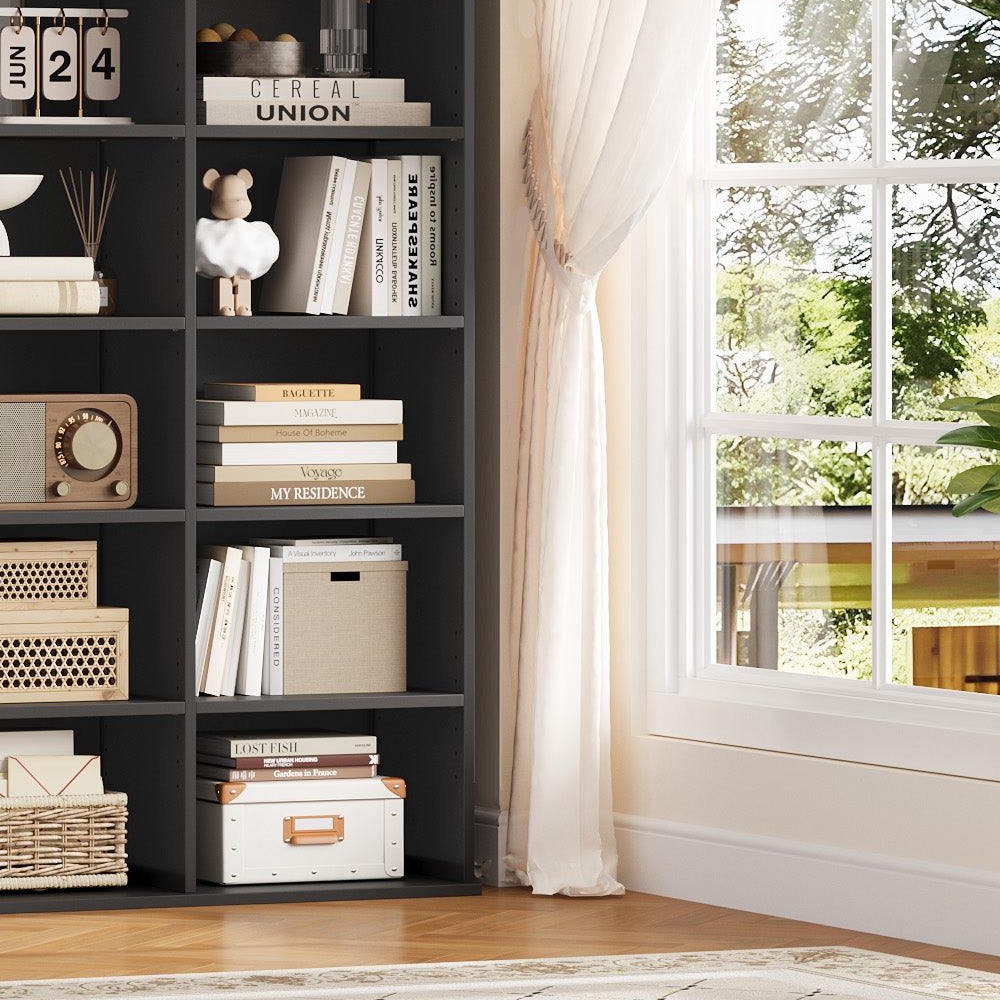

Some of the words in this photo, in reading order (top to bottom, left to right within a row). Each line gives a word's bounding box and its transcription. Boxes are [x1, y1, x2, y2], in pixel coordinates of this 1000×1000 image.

[10, 46, 26, 88] JUN
[49, 50, 72, 82] 2
[92, 48, 116, 80] 4
[251, 79, 360, 99] CEREAL
[256, 105, 350, 121] UNION
[282, 389, 335, 398] BAGUETTE
[294, 408, 338, 418] MAGAZINE
[276, 429, 300, 437] House
[315, 428, 347, 436] Boheme
[300, 466, 343, 480] Voyage
[271, 487, 291, 500] MY
[294, 486, 365, 500] RESIDENCE
[311, 550, 336, 558] Inventory
[235, 743, 267, 755] LOST
[270, 742, 297, 753] FISH
[274, 770, 303, 778] Gardens
